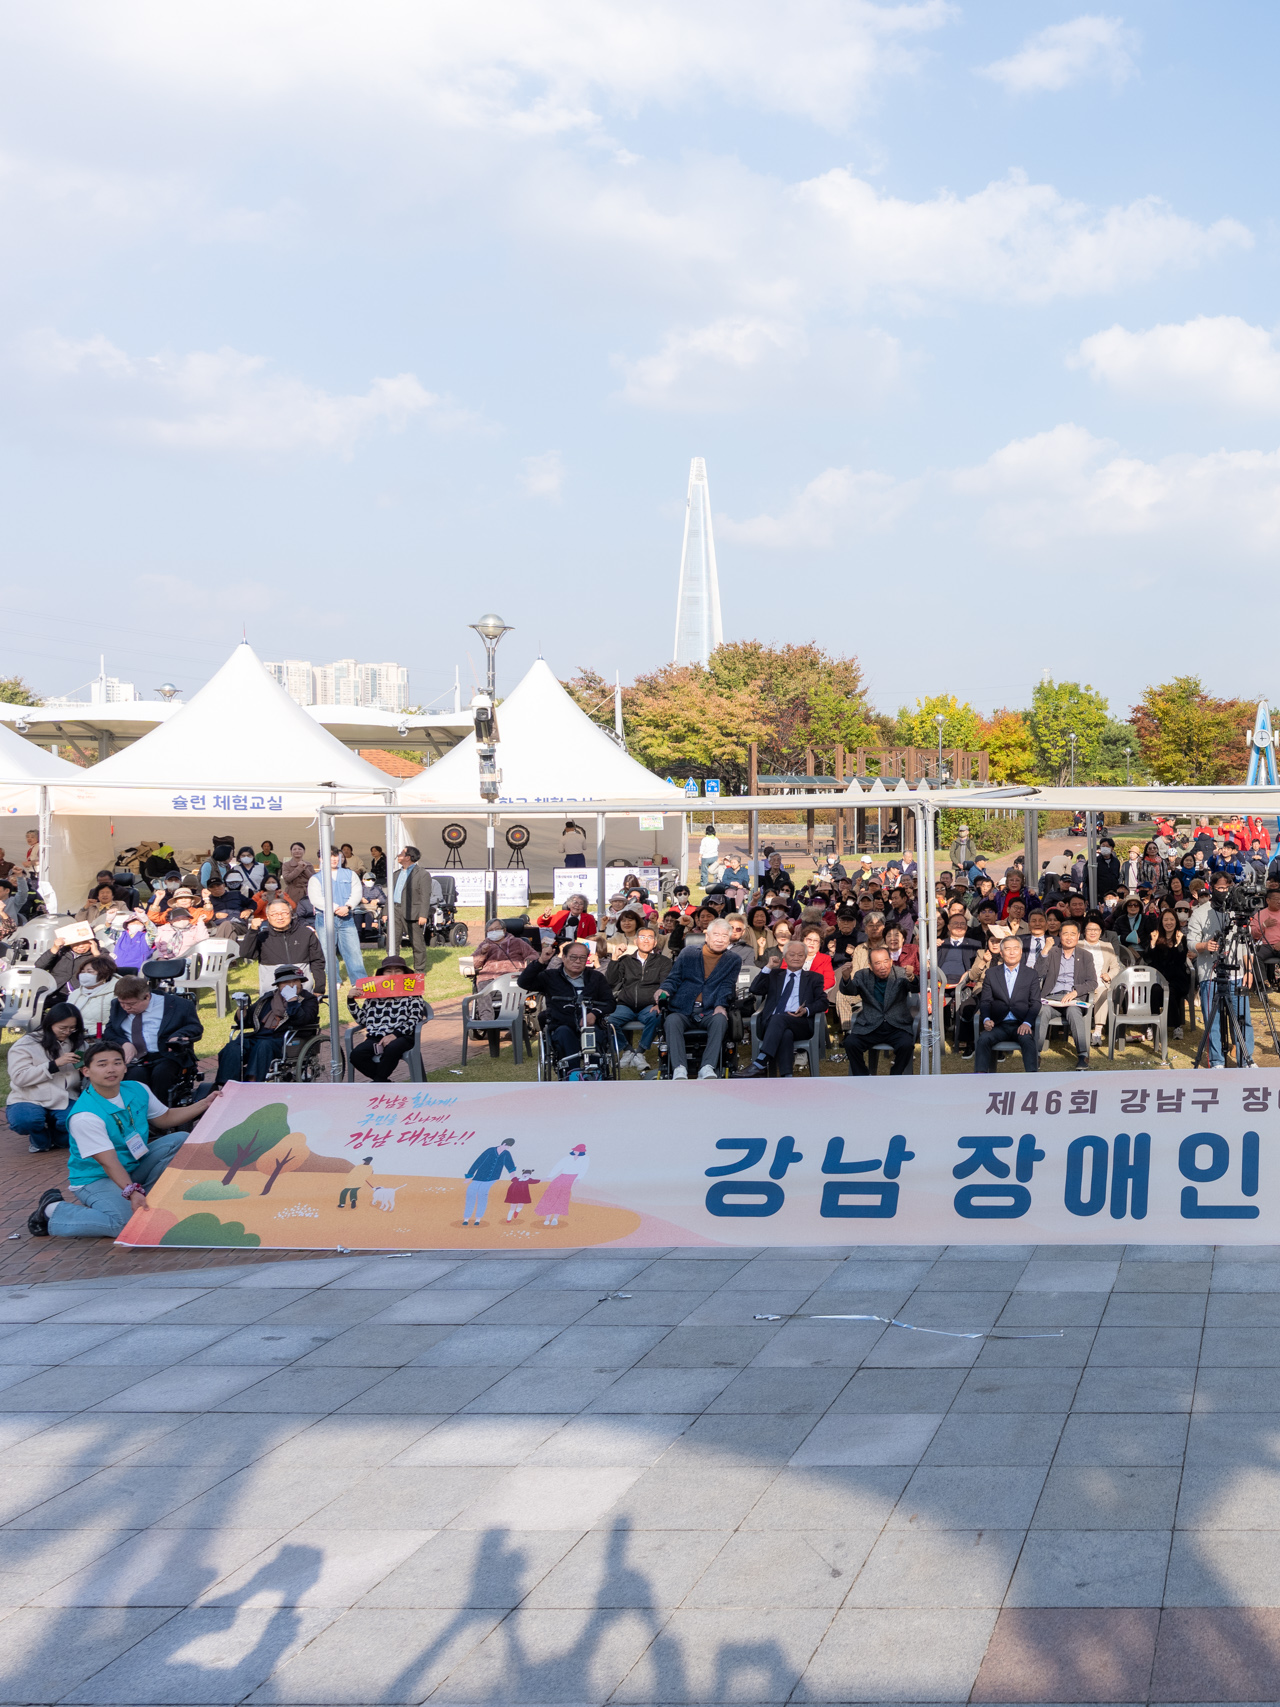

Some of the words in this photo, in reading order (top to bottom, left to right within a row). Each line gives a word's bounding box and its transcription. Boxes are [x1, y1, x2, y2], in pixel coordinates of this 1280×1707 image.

[172, 795, 206, 811] 슐런
[213, 795, 283, 811] 체험교실
[366, 1094, 409, 1109] 강남을
[411, 1091, 458, 1109] 힘차게!
[985, 1089, 1098, 1116] 제46회
[1120, 1087, 1221, 1114] 강남구
[357, 1113, 398, 1127] 구민을
[400, 1111, 452, 1125] 신나게!
[344, 1128, 394, 1149] 강남
[397, 1127, 476, 1147] 대전환!!
[704, 1134, 917, 1219] 강남
[952, 1130, 1261, 1221] 장애인
